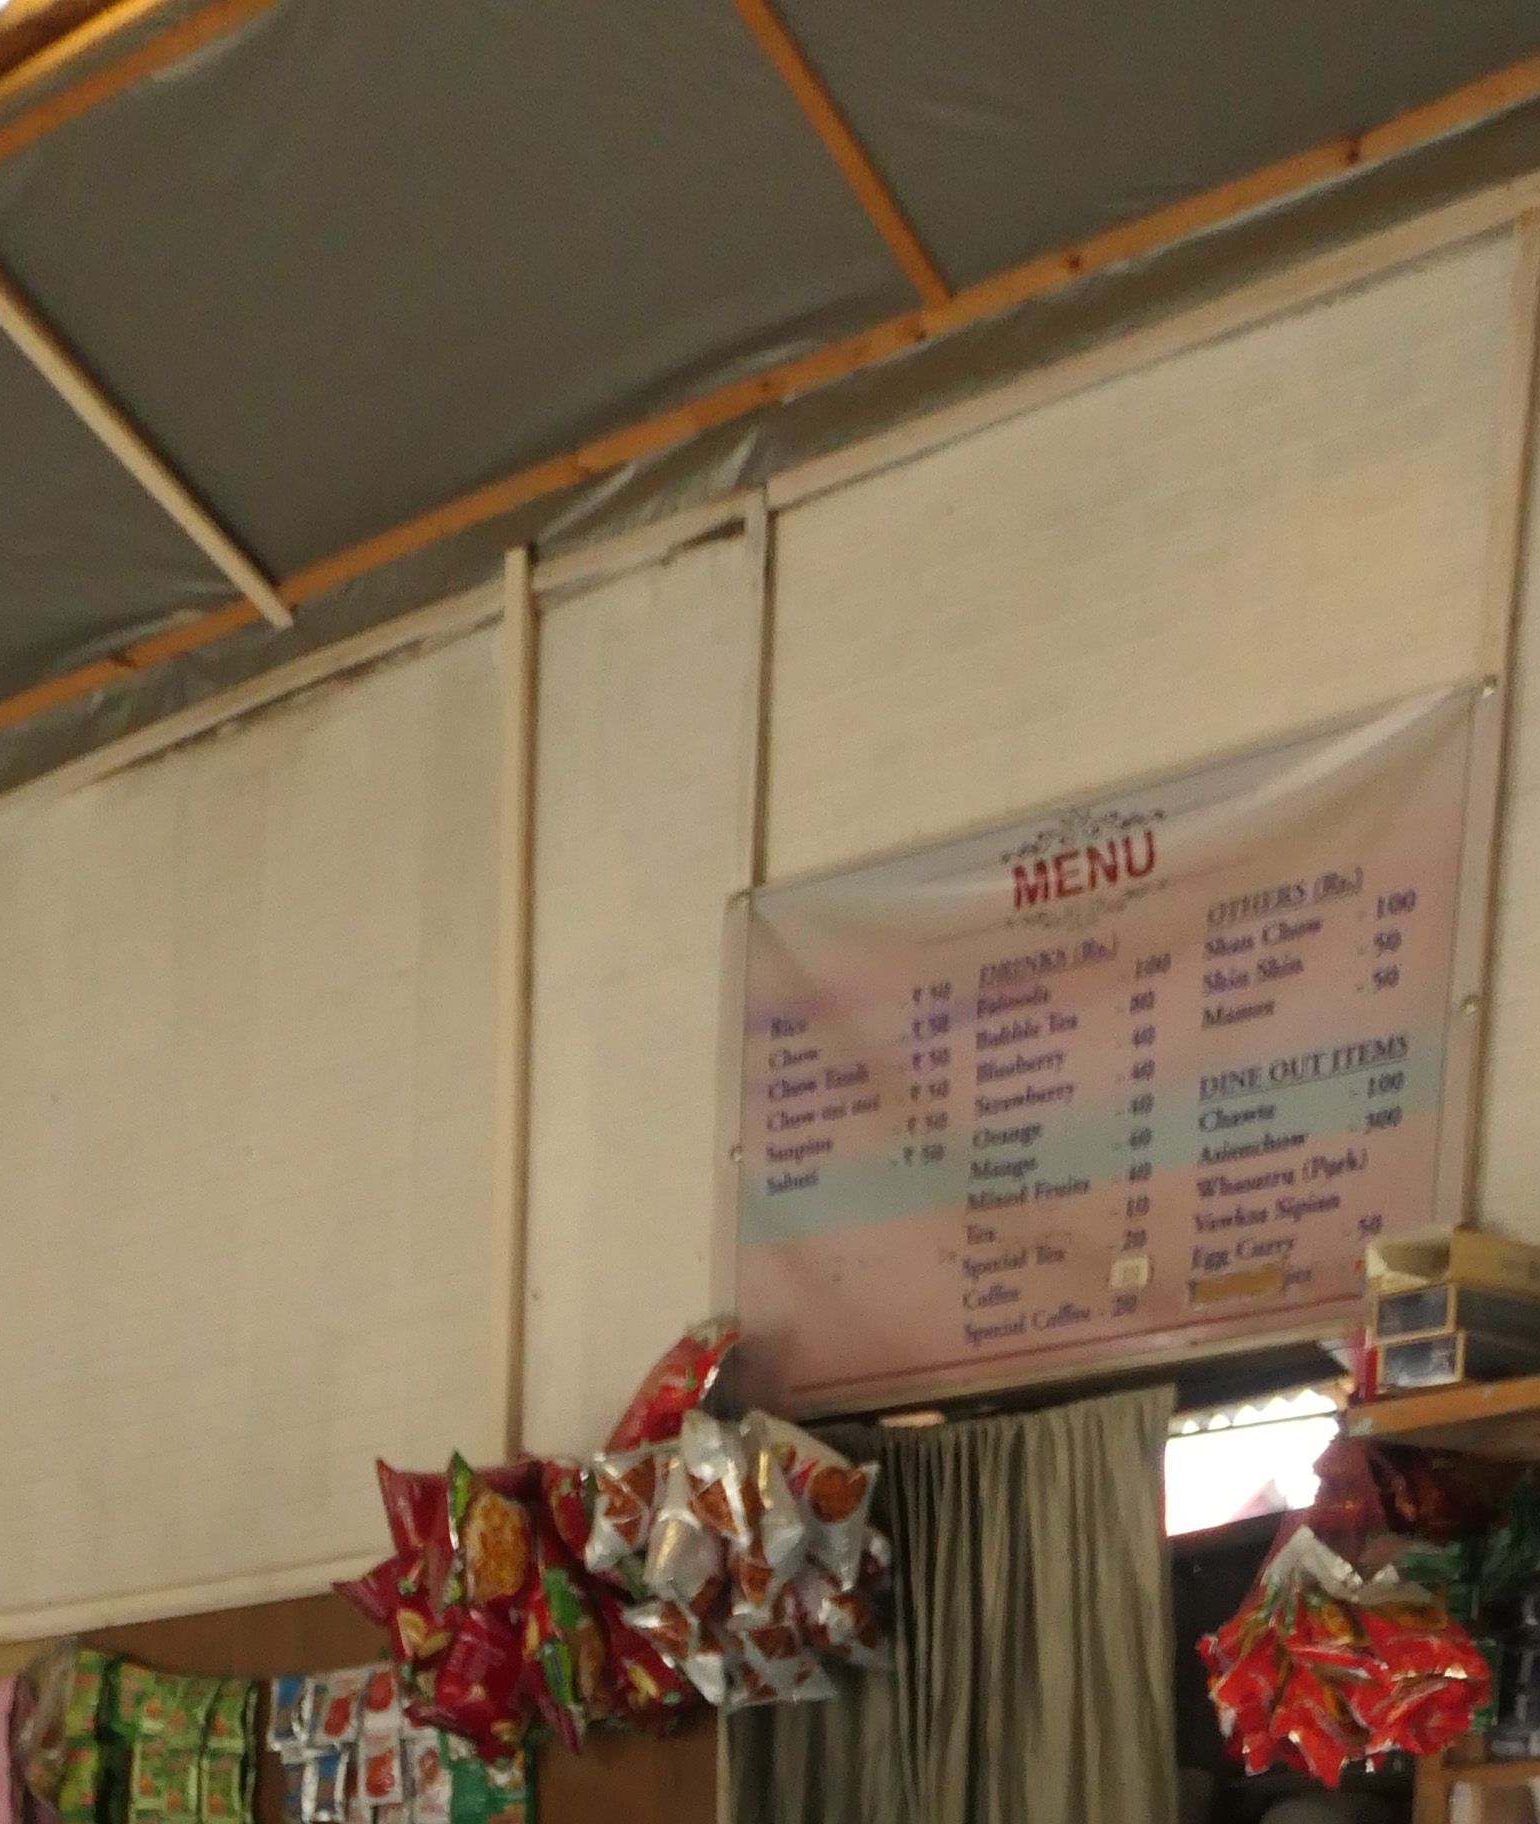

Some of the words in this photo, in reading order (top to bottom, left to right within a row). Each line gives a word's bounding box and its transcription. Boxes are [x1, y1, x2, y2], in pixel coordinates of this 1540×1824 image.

[1013, 829, 1156, 911] MENU
[1377, 888, 1417, 920] 100
[1199, 1066, 1260, 1101] DINE
[1269, 1052, 1328, 1084] OUT
[1331, 1032, 1408, 1074] ITEMS
[1367, 1069, 1405, 1098] 100
